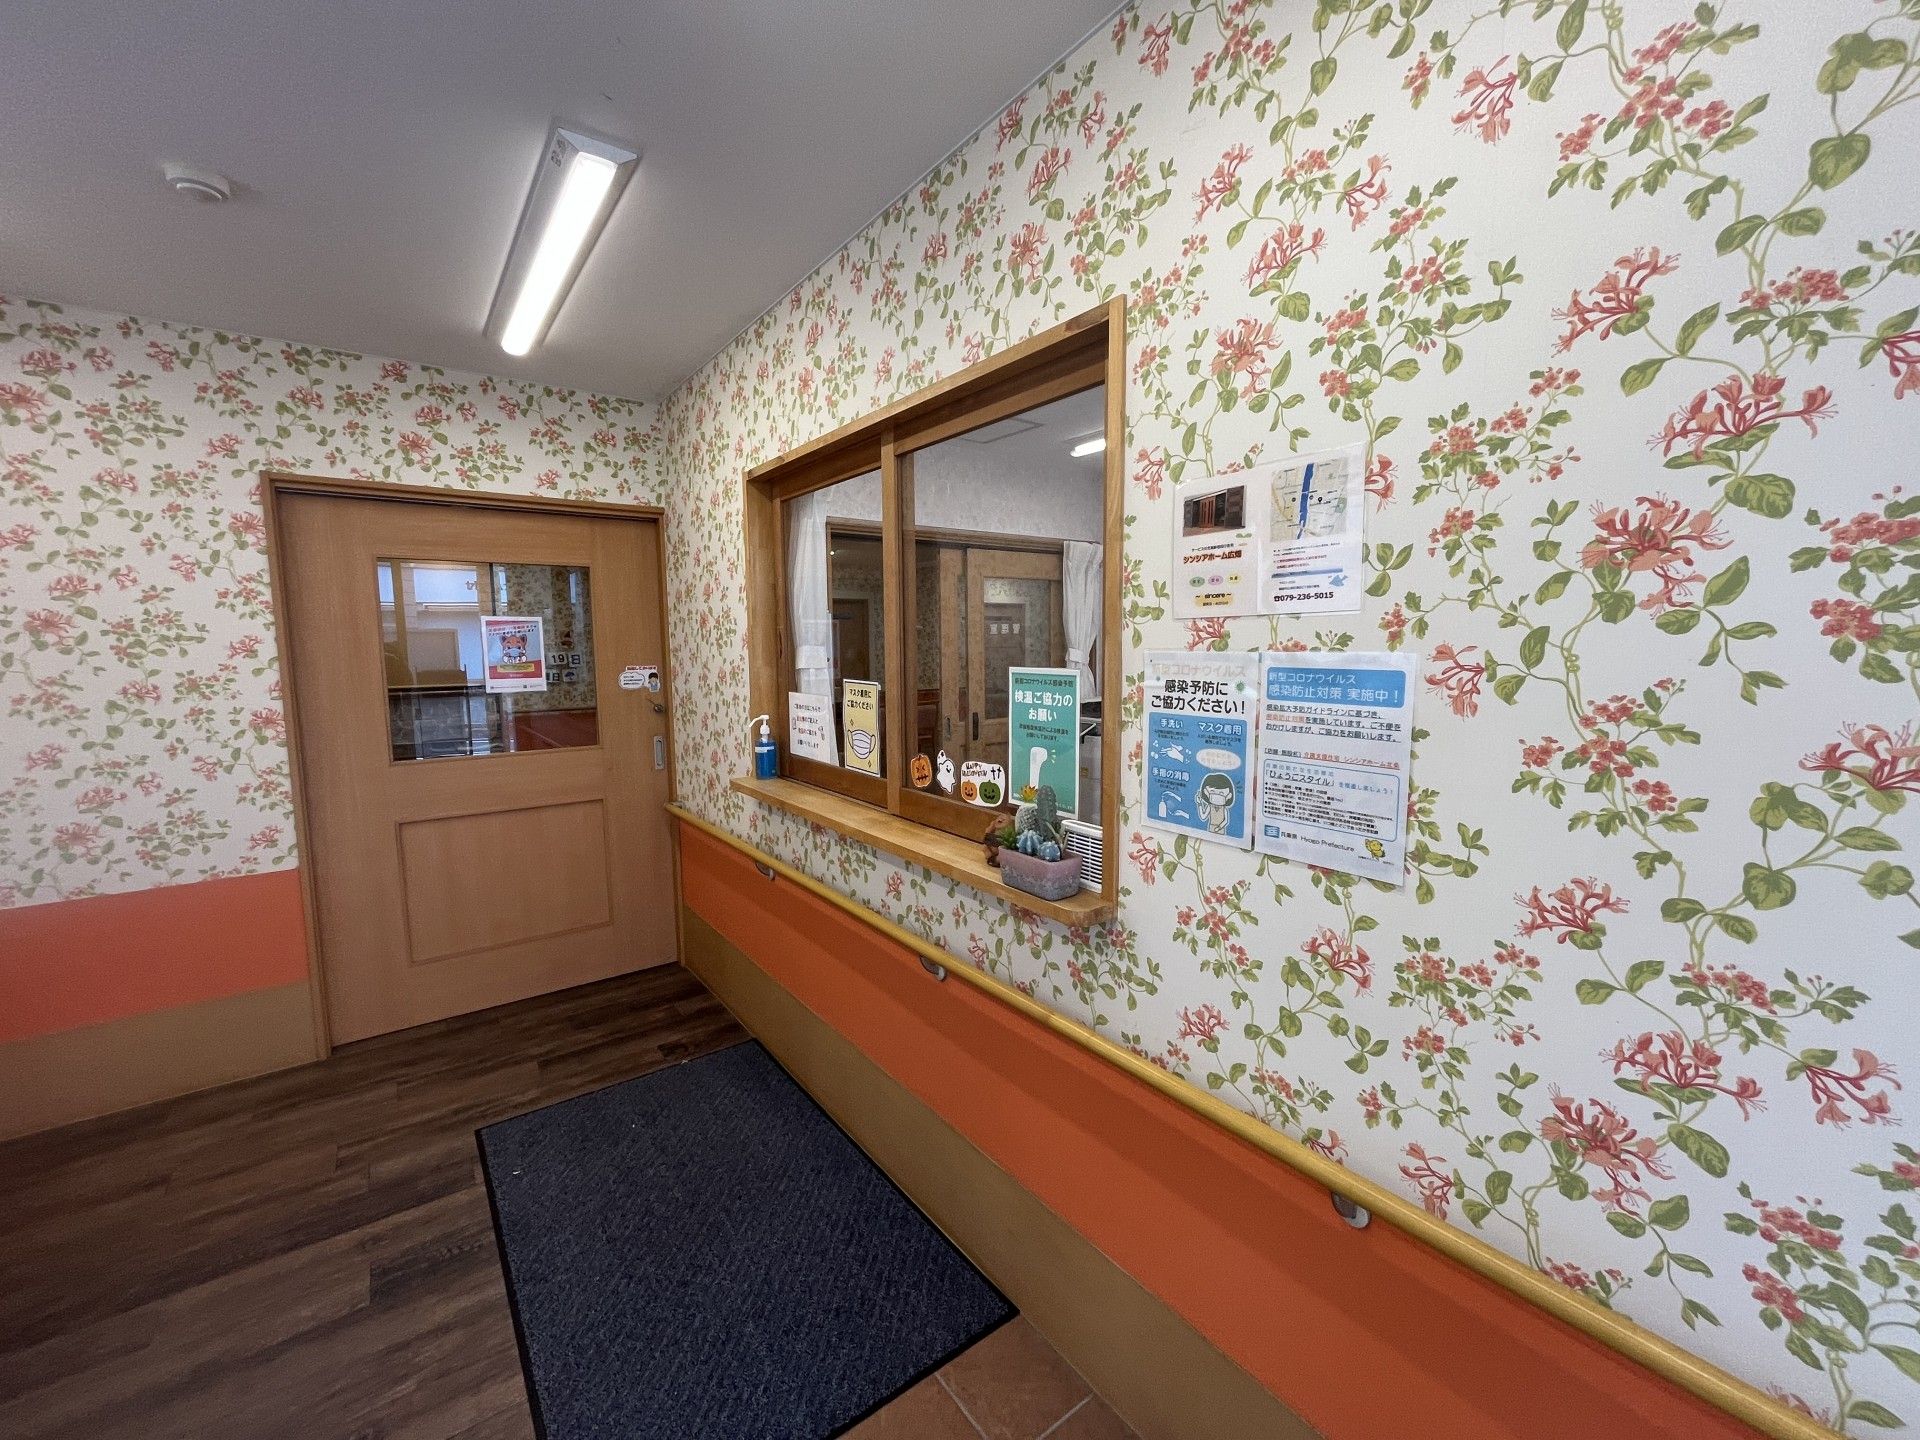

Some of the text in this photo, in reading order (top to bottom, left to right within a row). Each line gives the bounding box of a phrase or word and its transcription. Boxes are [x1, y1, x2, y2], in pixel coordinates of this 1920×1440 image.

[1268, 672, 1356, 684] 新型コロナウイルス
[1164, 680, 1229, 696] 感染予防に
[1268, 684, 1342, 700] 感染防止対策
[1014, 689, 1073, 707] 検温ご協力の
[846, 699, 874, 711] ご協力ください
[1028, 707, 1057, 722] お願い
[1160, 718, 1183, 729] 手洗い
[1198, 722, 1242, 735] マスク着用
[965, 762, 983, 770] HAPPY
[1321, 839, 1355, 852] Prefecture
